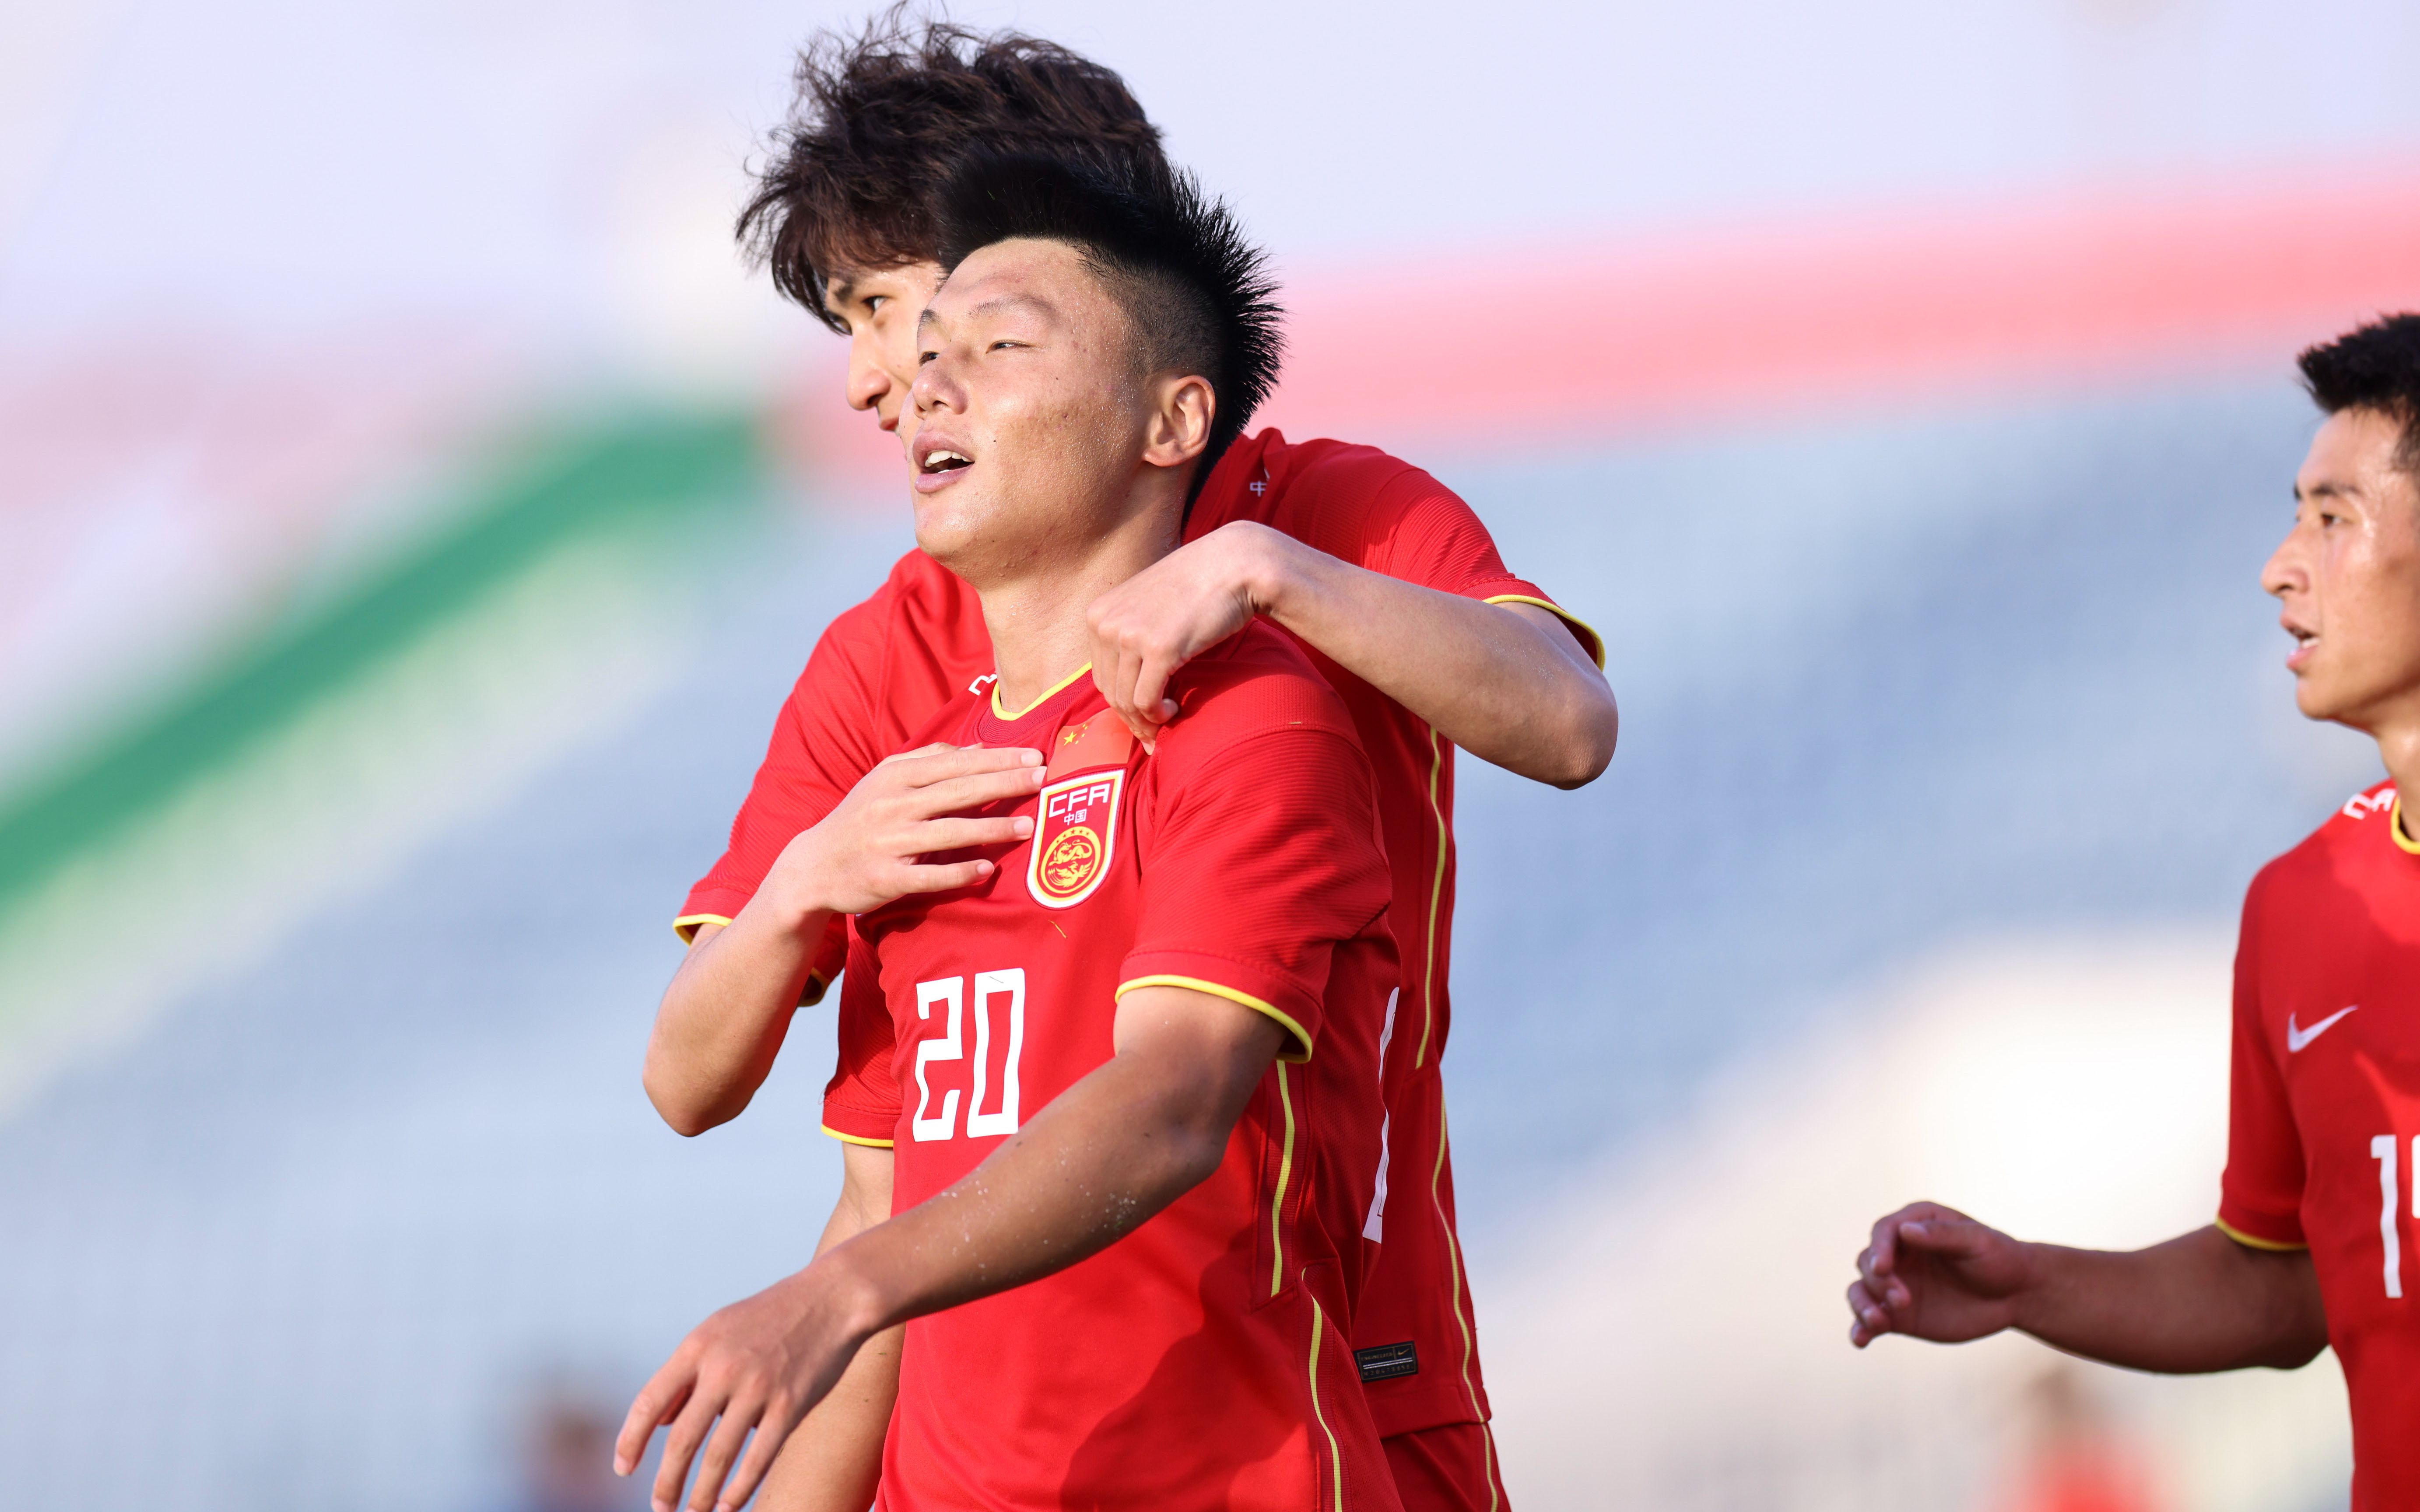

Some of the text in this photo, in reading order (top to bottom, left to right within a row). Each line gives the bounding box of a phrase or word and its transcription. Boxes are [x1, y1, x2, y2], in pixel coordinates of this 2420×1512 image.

[1049, 783, 1110, 818] CFA
[1064, 808, 1087, 826] 中国
[912, 967, 1025, 1142] 20
[2371, 1134, 2420, 1298] 1
